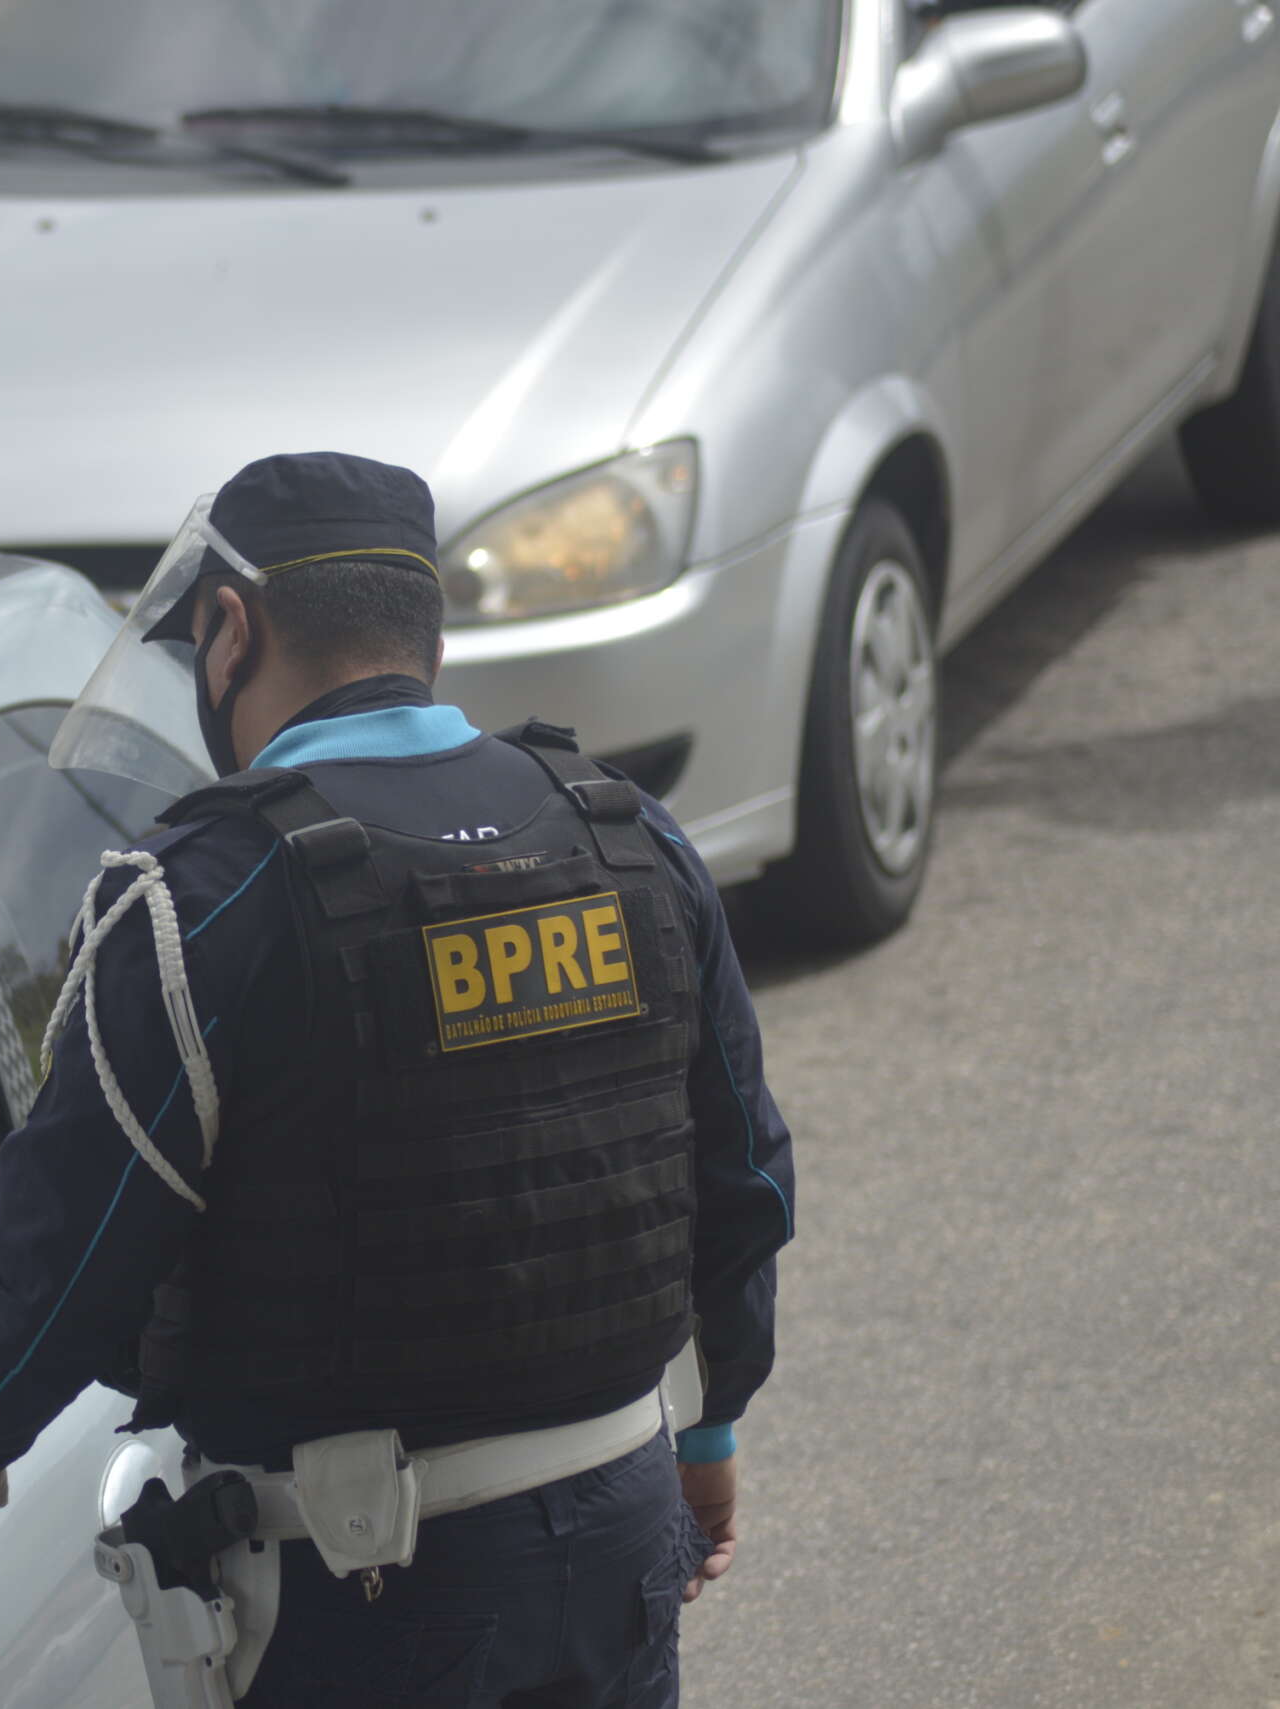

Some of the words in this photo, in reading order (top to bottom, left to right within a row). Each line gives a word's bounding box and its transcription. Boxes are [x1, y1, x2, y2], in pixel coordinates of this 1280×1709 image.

[432, 905, 629, 1014] BPRE
[445, 1014, 492, 1039] BATALHÃO
[492, 1013, 504, 1032] DE
[506, 1005, 540, 1029] POLÍCIA
[542, 996, 590, 1021] RODOVIÁRIA
[591, 990, 632, 1012] ESTADUAL
